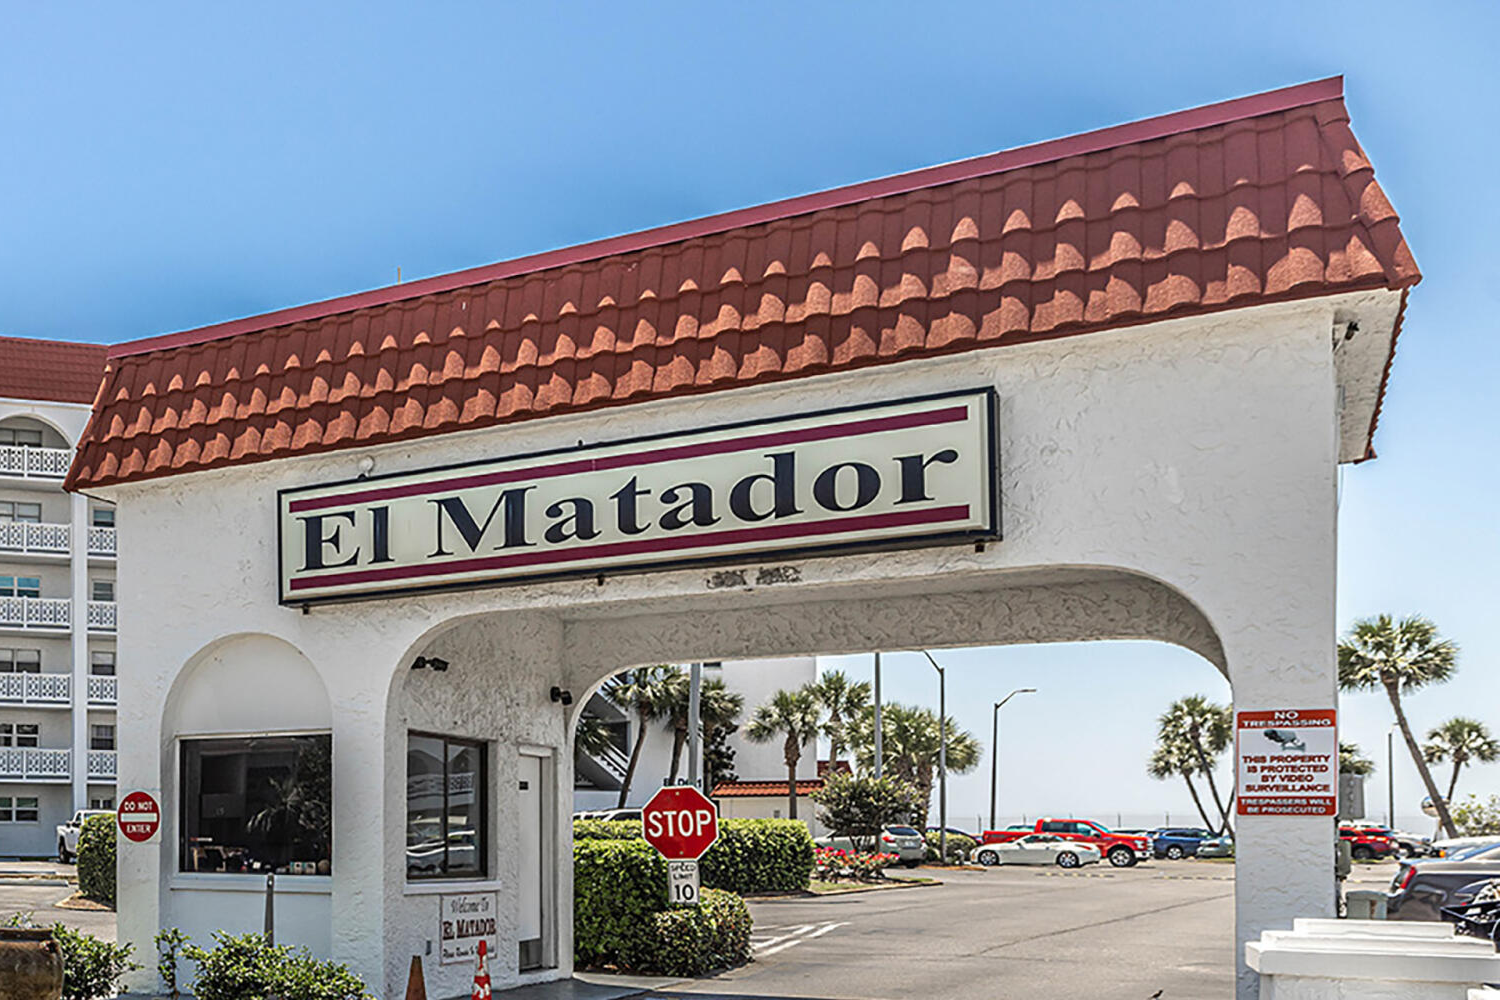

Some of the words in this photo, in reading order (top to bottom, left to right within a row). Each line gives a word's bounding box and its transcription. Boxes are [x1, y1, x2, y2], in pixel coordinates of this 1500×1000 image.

[295, 505, 395, 573] El
[427, 448, 959, 558] Matador
[1274, 710, 1299, 720] NO
[1243, 718, 1332, 728] TRESPASSING
[1242, 755, 1267, 763] THIS
[1269, 754, 1331, 763] PROPERTY
[1247, 765, 1258, 773] IS
[1260, 764, 1329, 773] PROTECTED
[1261, 775, 1277, 783] BY
[1279, 774, 1314, 782] VIDEO
[1245, 783, 1331, 793] SURVEILLANCE
[124, 801, 136, 811] DO
[137, 801, 153, 811] NOT
[1241, 798, 1307, 806] TRESPASSERS
[1246, 806, 1260, 814] BE
[1261, 806, 1326, 814] PROSECUTED
[126, 823, 151, 834] ENTER
[648, 809, 711, 838] STOP
[670, 863, 697, 873] SPEED
[672, 873, 694, 881] LIMIT
[674, 883, 695, 901] 10
[456, 918, 497, 939] MATADOR
